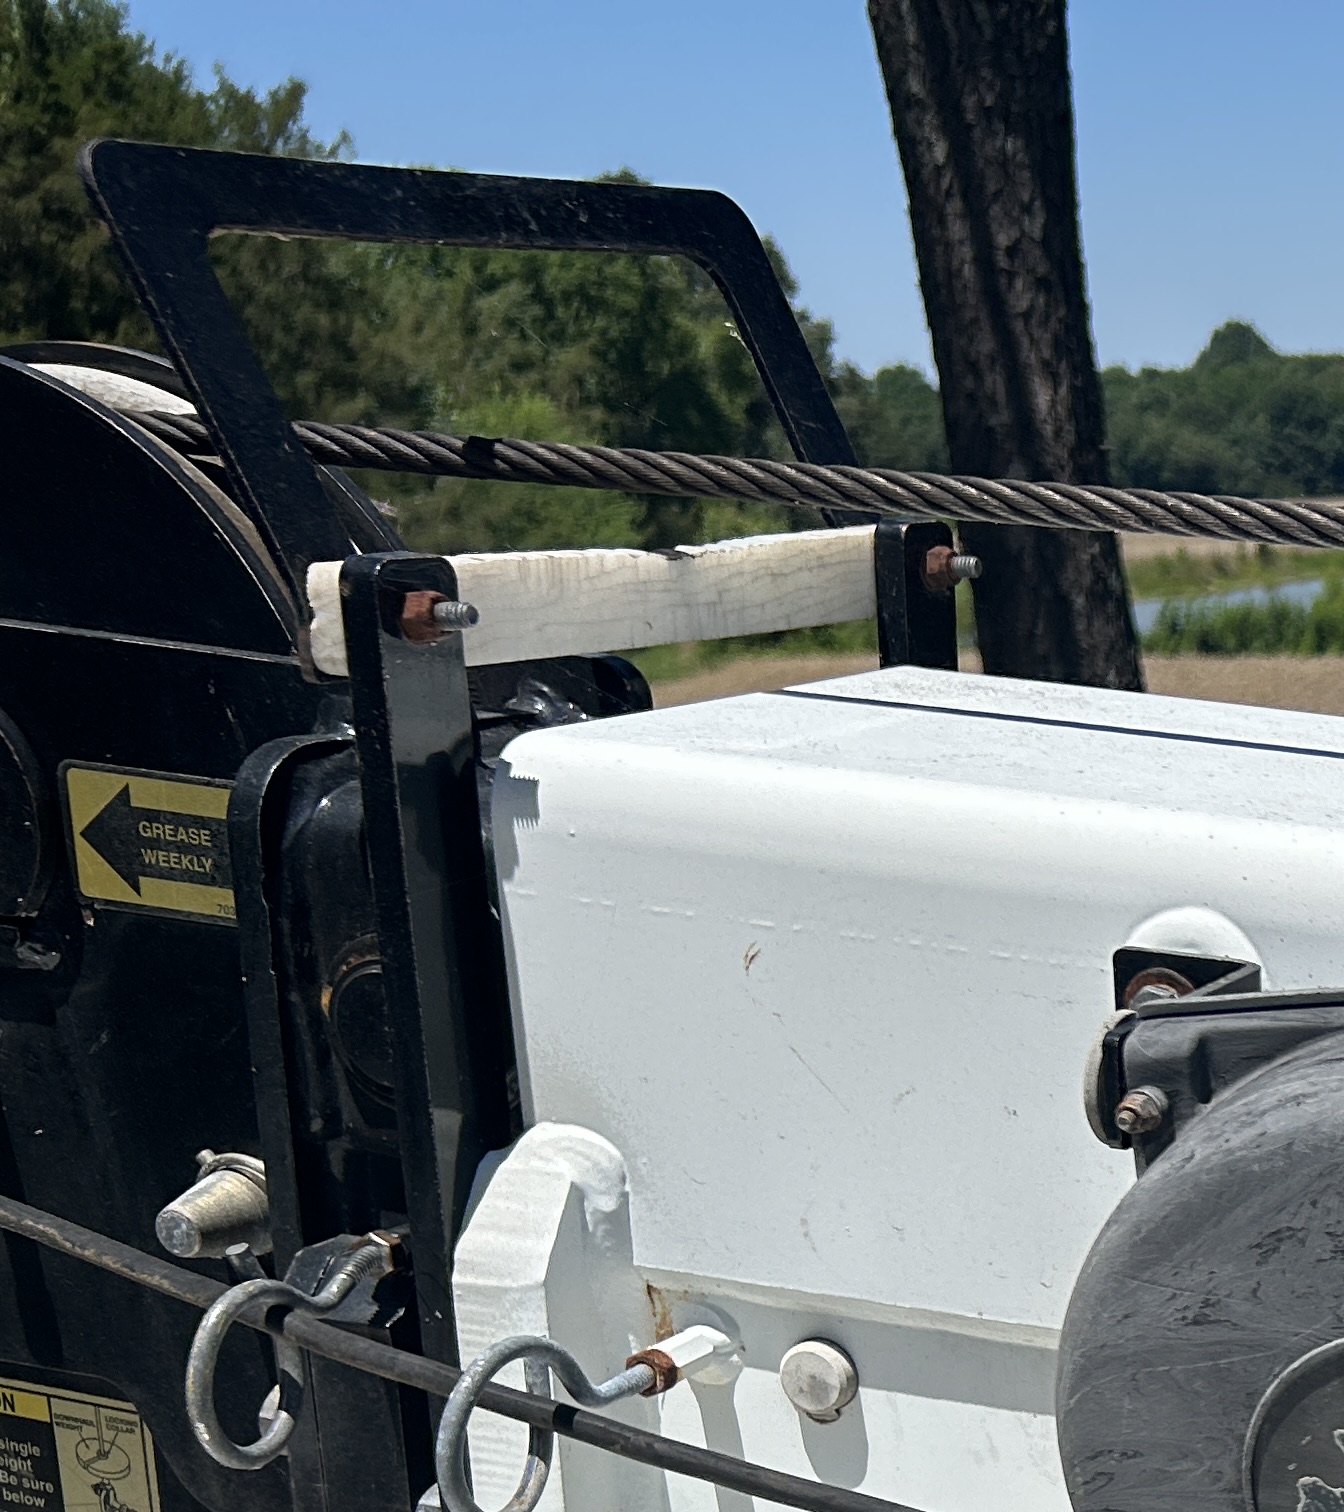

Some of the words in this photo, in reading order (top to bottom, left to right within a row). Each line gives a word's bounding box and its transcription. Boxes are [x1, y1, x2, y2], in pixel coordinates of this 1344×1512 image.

[138, 821, 212, 847] GREASE
[140, 848, 213, 874] WEEKLY
[0, 1469, 18, 1486] Be
[21, 1477, 54, 1494] sure
[2, 1487, 45, 1508] below
